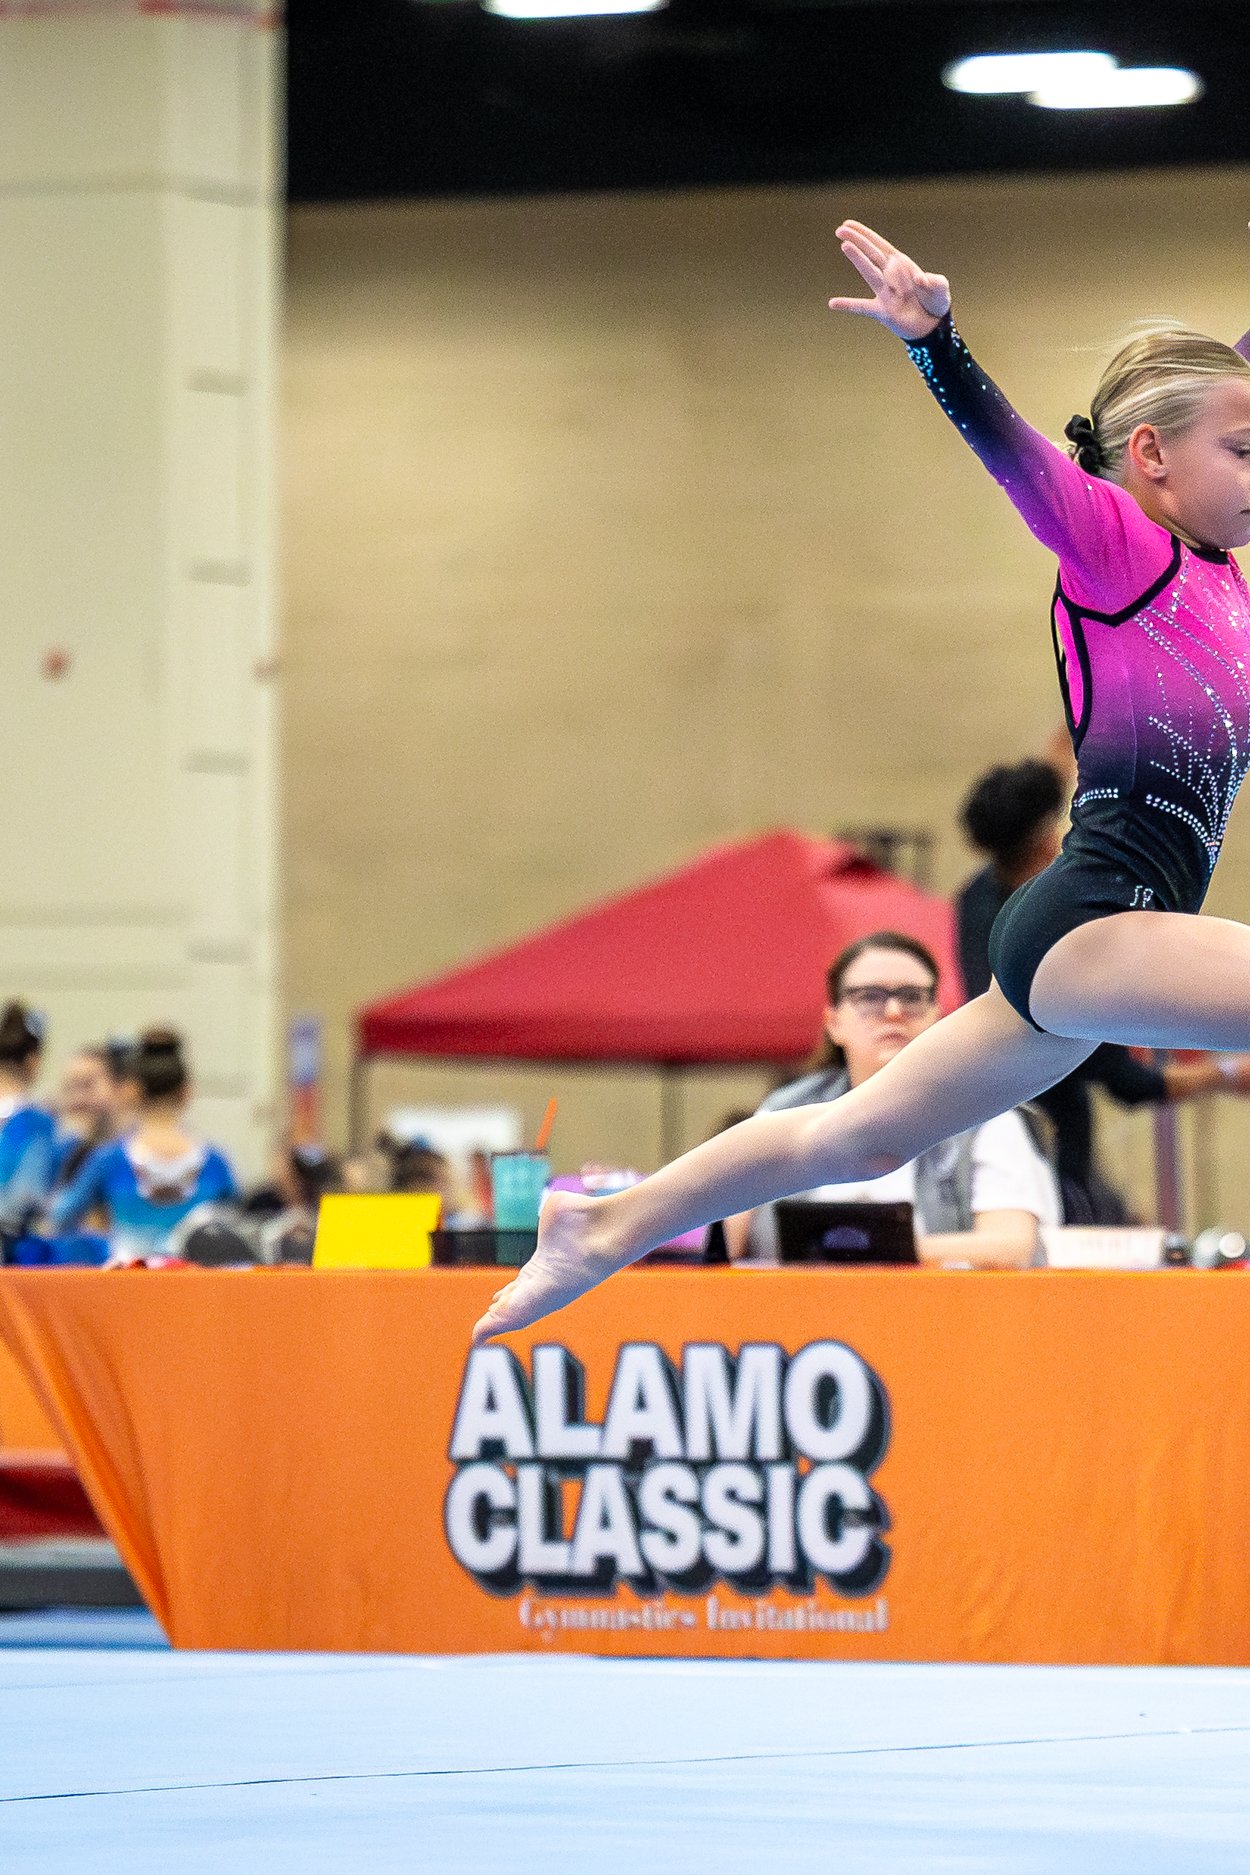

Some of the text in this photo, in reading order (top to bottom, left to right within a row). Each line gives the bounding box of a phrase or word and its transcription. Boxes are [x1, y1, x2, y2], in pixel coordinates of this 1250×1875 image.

[448, 1340, 884, 1464] ALAMO
[444, 1462, 886, 1590] CLASSIC
[518, 1595, 889, 1643] Gymnastics Invitational
